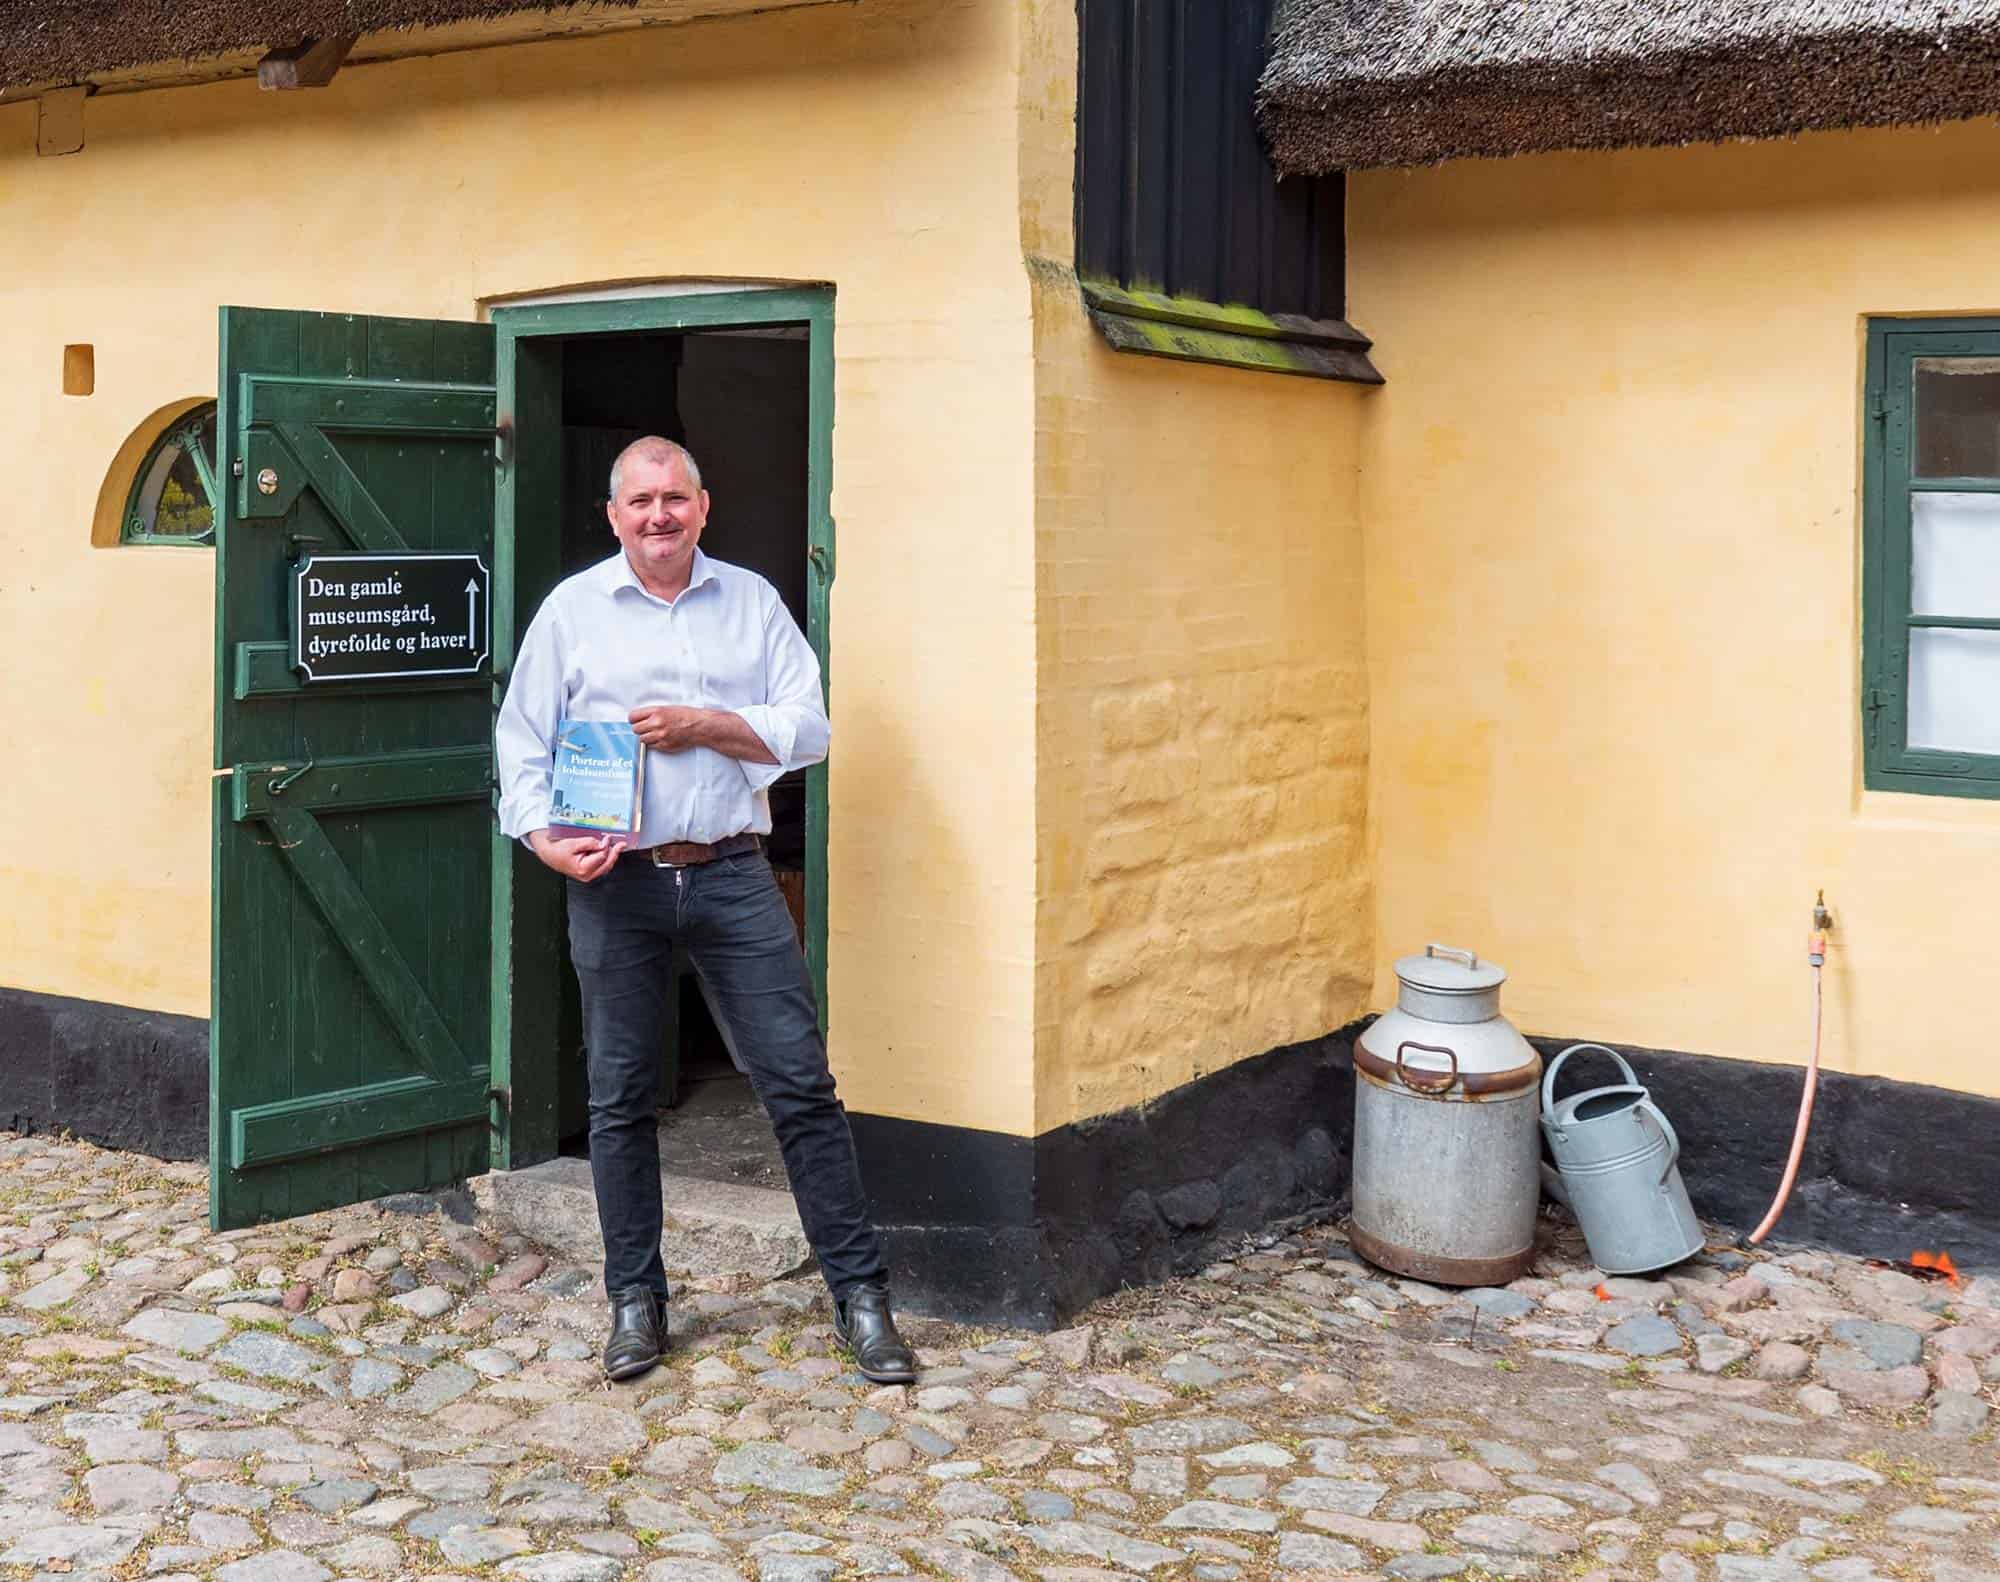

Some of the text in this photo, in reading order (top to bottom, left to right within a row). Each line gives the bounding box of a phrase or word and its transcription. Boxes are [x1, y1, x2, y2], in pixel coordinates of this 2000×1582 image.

[308, 577, 402, 600] Den gamle
[308, 603, 436, 627] museumsgård,
[308, 632, 467, 657] dyrefolde og haver
